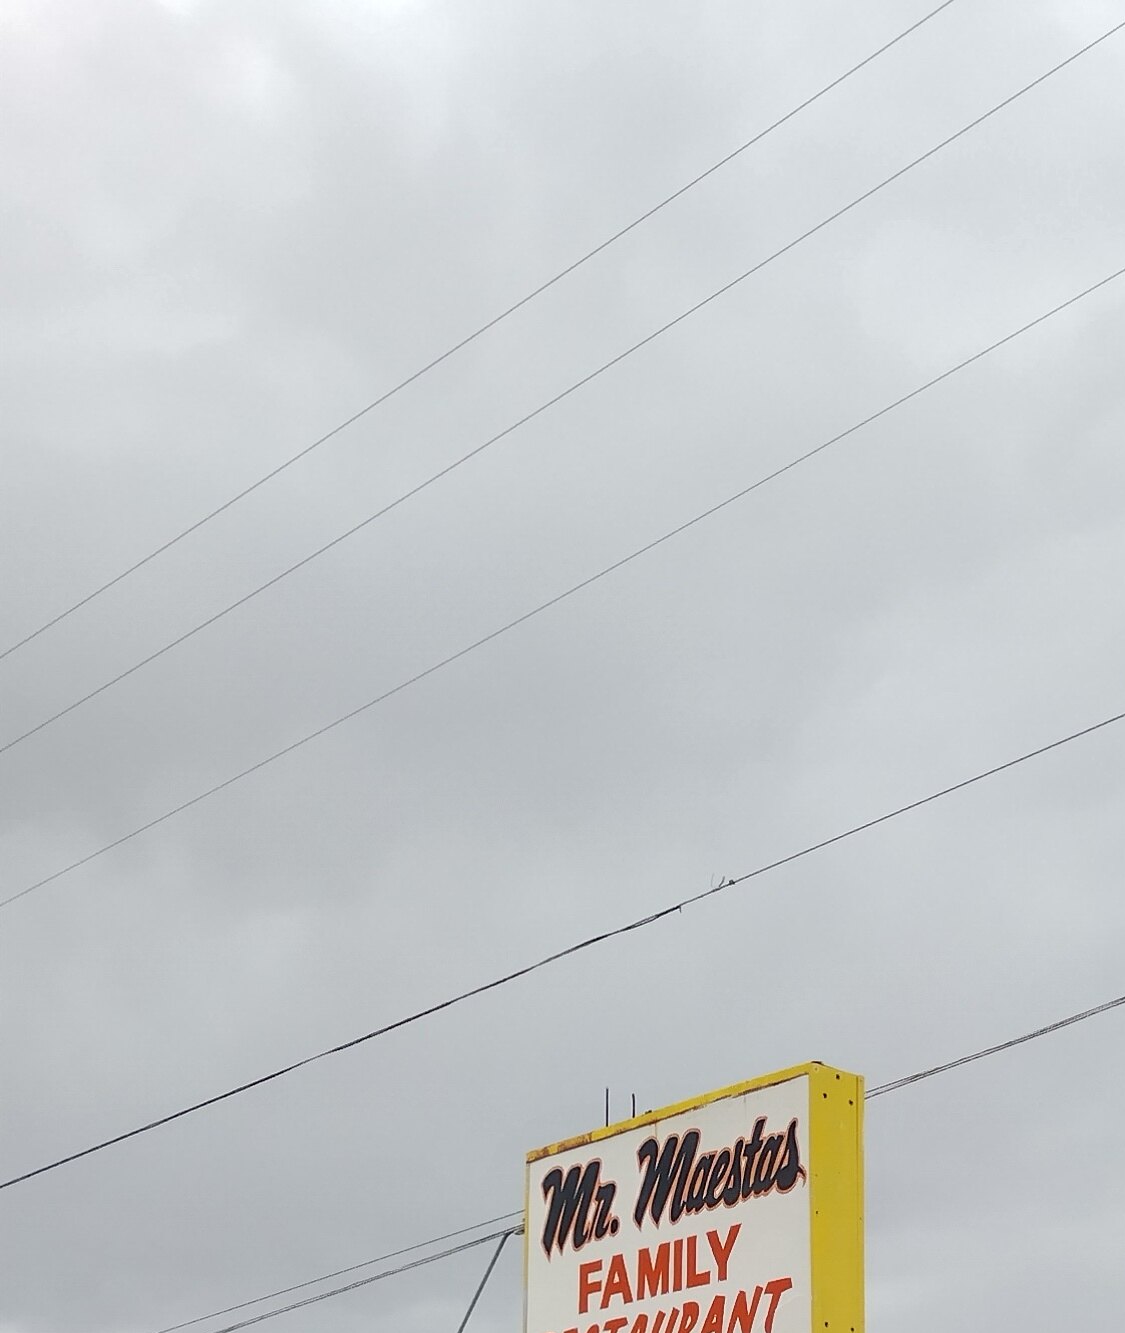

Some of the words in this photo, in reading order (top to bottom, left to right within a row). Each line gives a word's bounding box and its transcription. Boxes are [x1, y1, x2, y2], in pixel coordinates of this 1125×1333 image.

[541, 1159, 619, 1262] Mr.
[632, 1114, 806, 1230] Maestas
[578, 1223, 742, 1314] FAMILY
